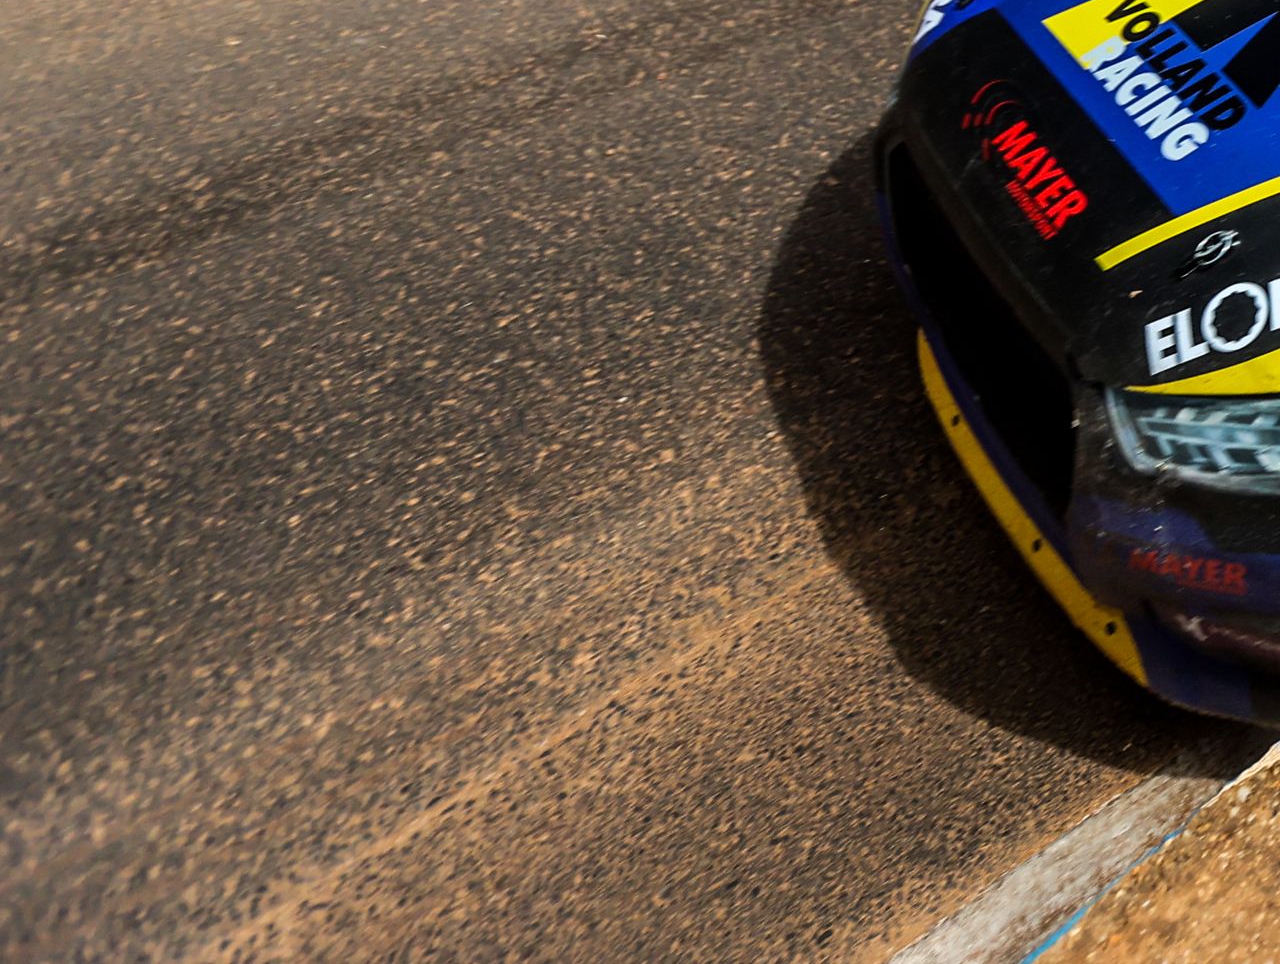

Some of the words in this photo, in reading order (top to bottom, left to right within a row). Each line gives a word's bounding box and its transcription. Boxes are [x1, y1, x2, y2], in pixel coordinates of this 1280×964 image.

[1080, 35, 1210, 162] RACING
[991, 119, 1088, 231] MAYER
[1128, 546, 1248, 586] MAYER
